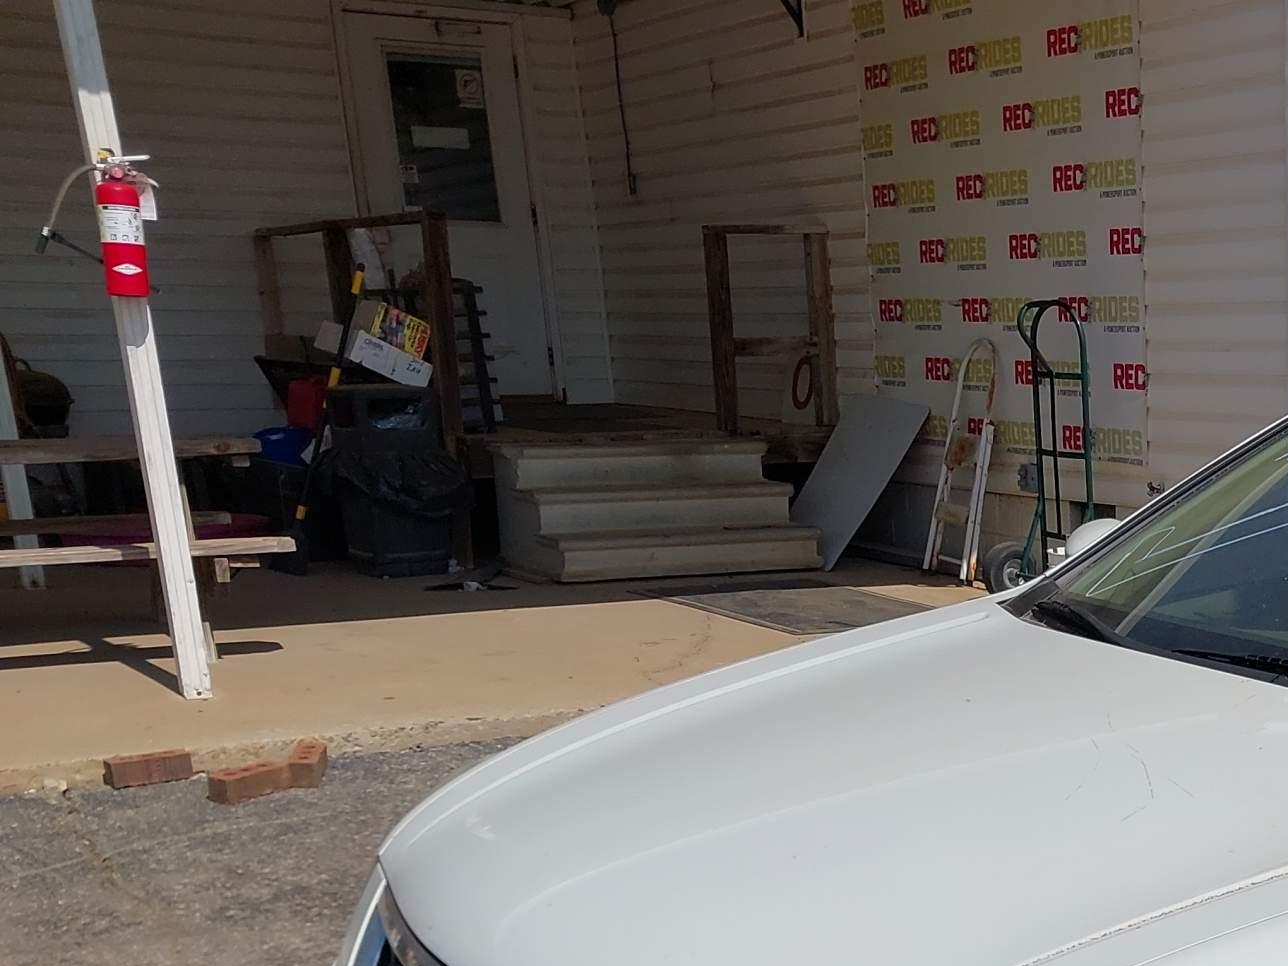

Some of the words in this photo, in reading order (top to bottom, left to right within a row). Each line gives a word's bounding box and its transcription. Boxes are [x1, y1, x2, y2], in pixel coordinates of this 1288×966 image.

[1046, 25, 1078, 57] REC
[1082, 15, 1133, 50] RIDES
[948, 46, 976, 75] REC
[978, 36, 1022, 69] RIDES
[864, 63, 889, 90] REC
[891, 55, 928, 84] RIDES
[1003, 103, 1033, 131] REC
[1035, 96, 1081, 125] RIDES
[1105, 87, 1140, 118] REC
[911, 117, 938, 144] REC
[939, 111, 980, 139] RIDES
[956, 174, 983, 200] REC
[985, 169, 1028, 197] RIDES
[1053, 164, 1084, 192] REC
[1086, 159, 1136, 188] RIDES
[872, 184, 896, 208] REC
[897, 179, 935, 205] RIDES
[920, 239, 944, 263] REC
[946, 236, 986, 261] RIDES
[1009, 234, 1040, 259] REC
[1041, 231, 1087, 257] RIDES
[1110, 228, 1143, 255] REC
[880, 299, 902, 322] REC
[904, 298, 942, 322] RIDES
[961, 298, 988, 322] REC
[1091, 296, 1139, 323] RIDES
[925, 357, 950, 380] REC
[1014, 360, 1034, 384] RE
[1113, 363, 1146, 390] REC
[1062, 425, 1084, 450] RE
[1096, 428, 1143, 456] RIDES
